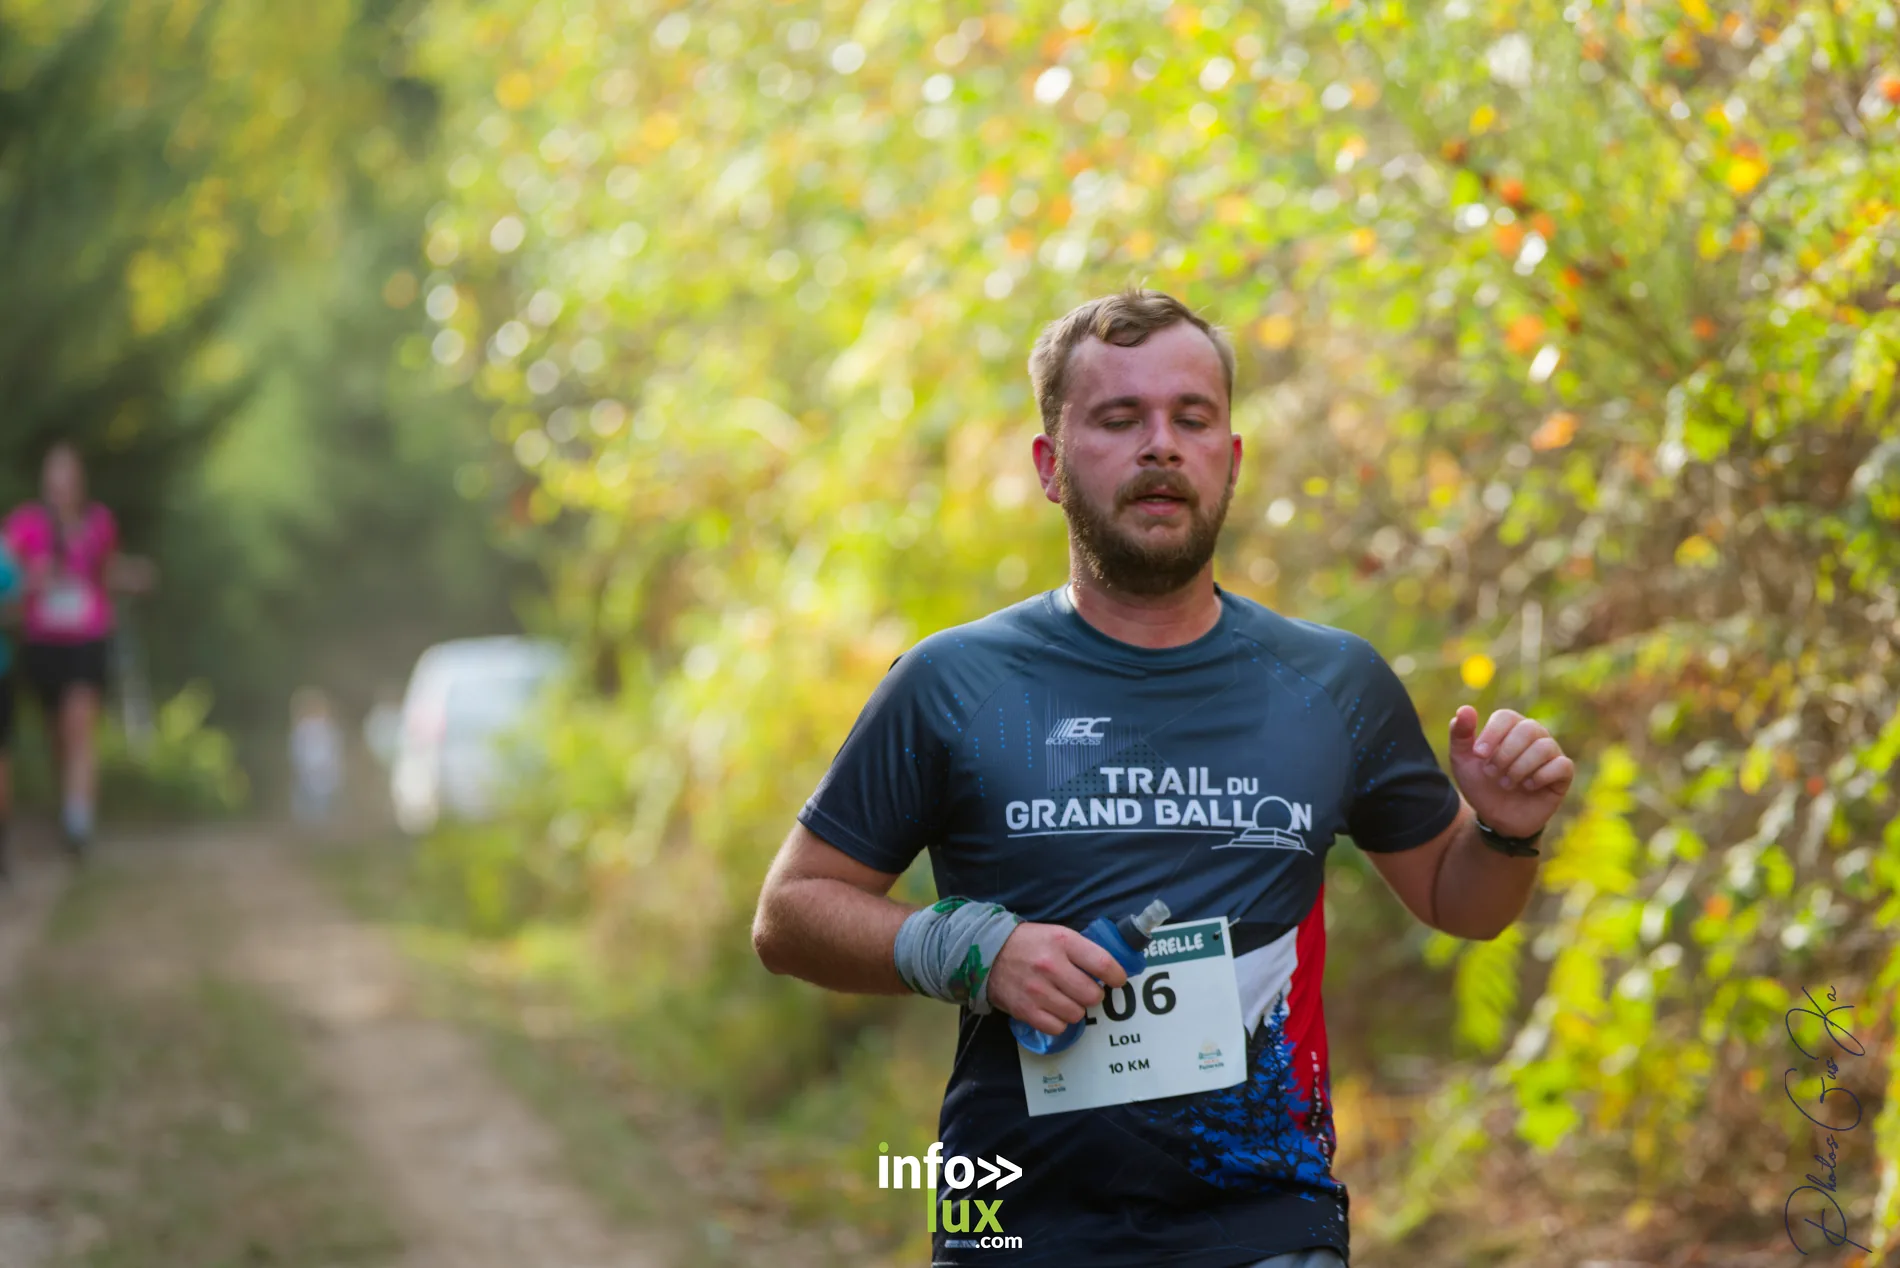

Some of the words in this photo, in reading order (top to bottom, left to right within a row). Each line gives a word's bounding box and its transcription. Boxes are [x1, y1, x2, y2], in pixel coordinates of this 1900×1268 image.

[1100, 766, 1222, 796] TRAIL
[1227, 777, 1259, 796] DU
[1005, 798, 1143, 830] GRAND
[1154, 796, 1312, 832] BALLON
[1085, 971, 1177, 1026] 06
[1109, 1032, 1141, 1048] Lou
[1108, 1062, 1124, 1075] 10
[1128, 1058, 1151, 1072] KM
